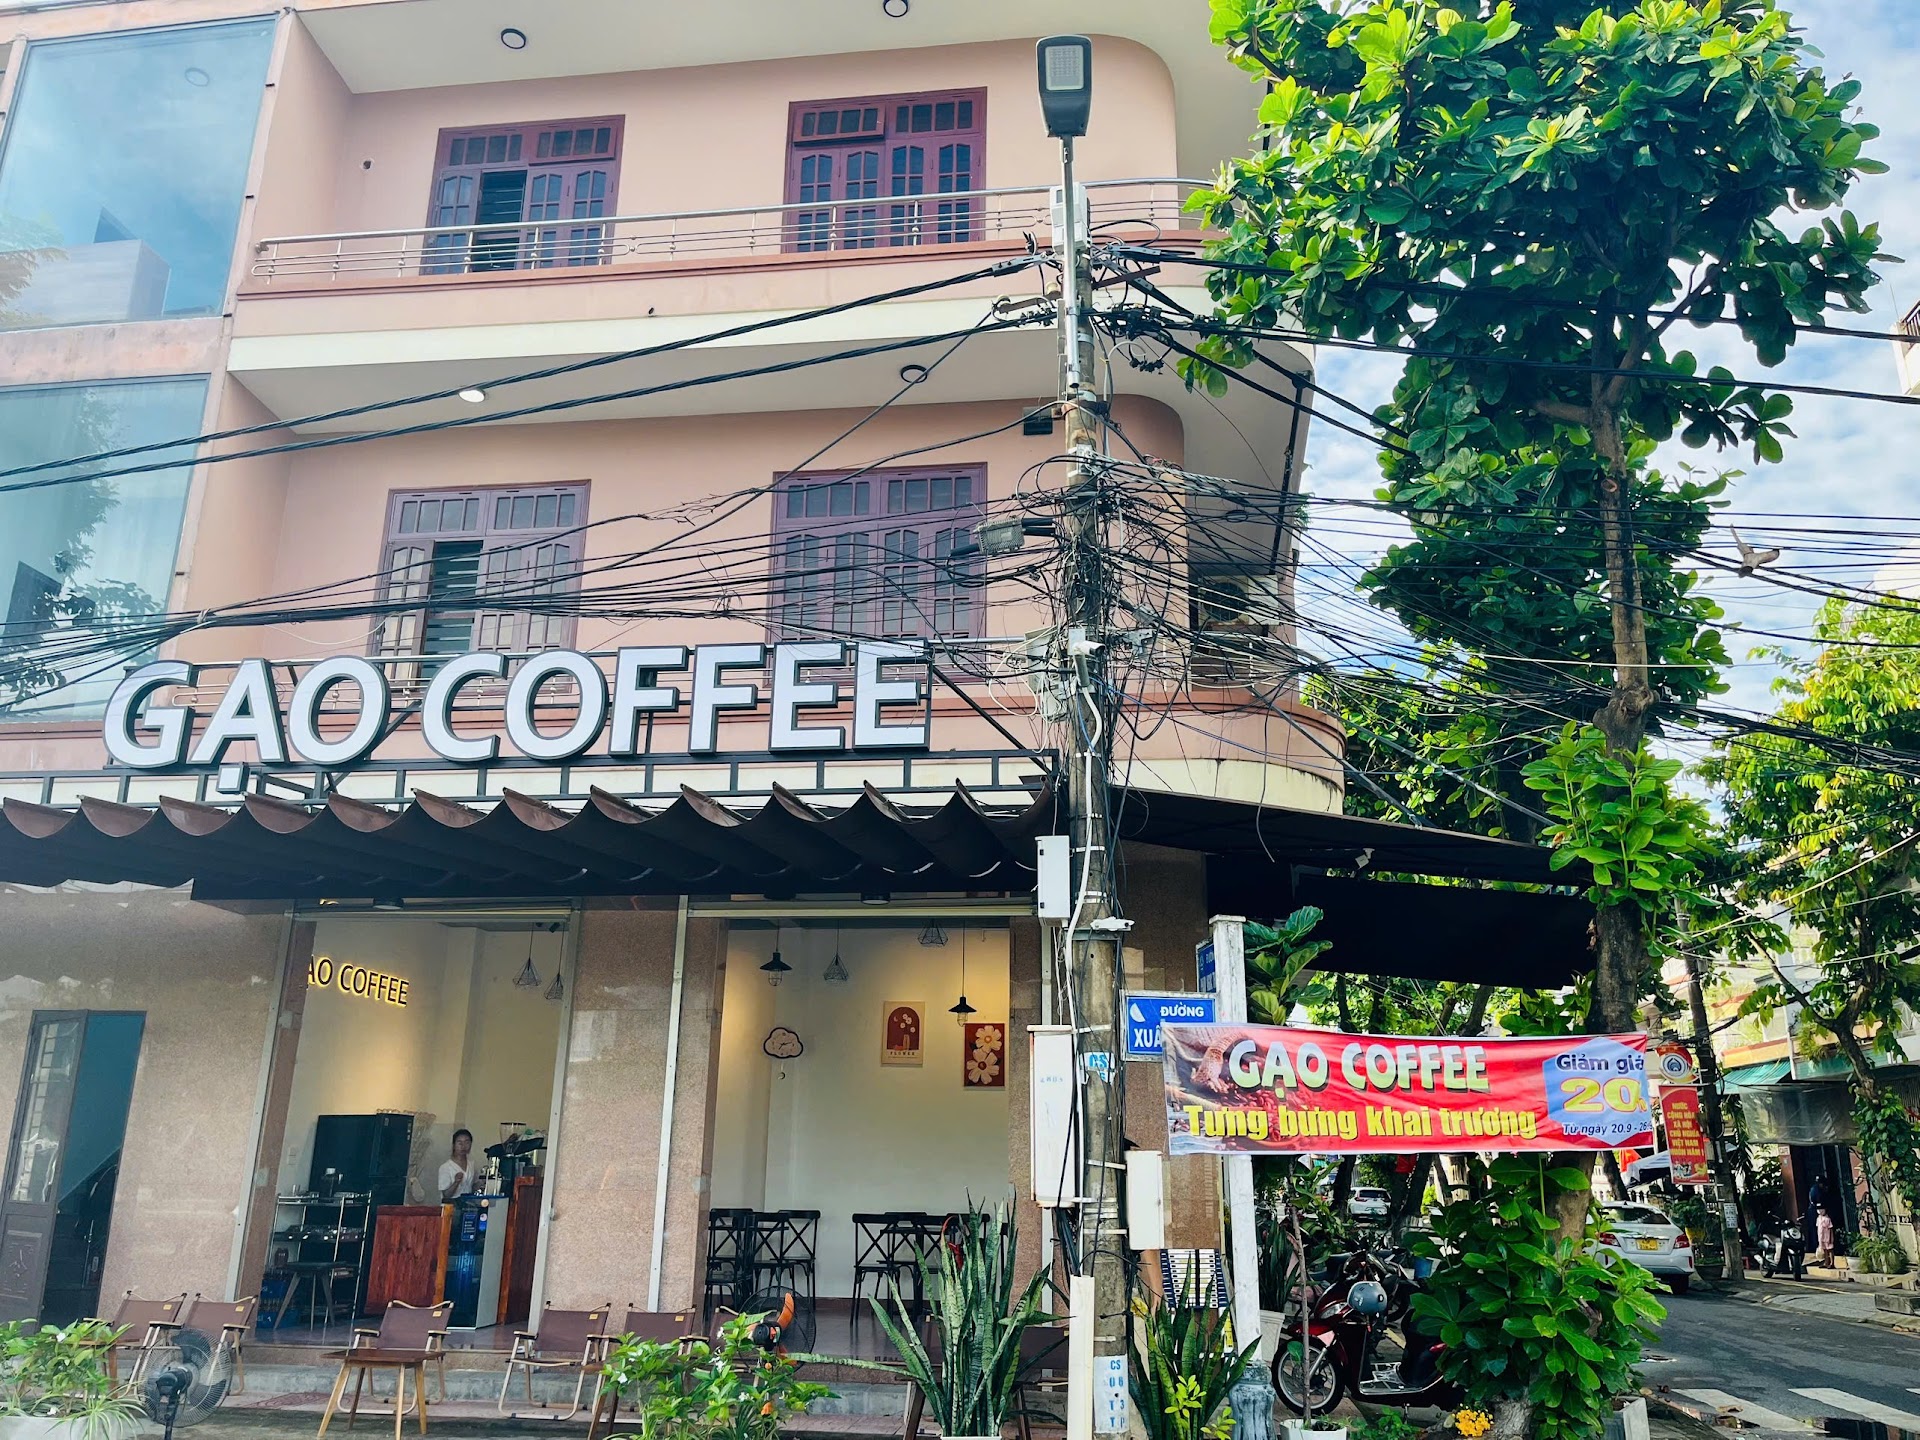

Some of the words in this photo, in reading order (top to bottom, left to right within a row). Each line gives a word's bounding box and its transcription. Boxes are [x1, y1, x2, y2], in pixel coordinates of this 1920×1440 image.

[102, 657, 390, 796] GẠO
[421, 641, 931, 764] COFFEE
[339, 963, 409, 1006] COFFEE
[1160, 1002, 1205, 1017] ĐƯỜNG
[1134, 1025, 1162, 1048] XUÂ
[1229, 1039, 1329, 1099] GẠO
[1342, 1043, 1490, 1093] COFFEE
[1557, 1053, 1609, 1071] Giảm
[1616, 1054, 1644, 1075] giá
[1279, 1105, 1358, 1140] bừng
[1365, 1105, 1433, 1137] khai
[1439, 1106, 1538, 1140] trương
[1563, 1122, 1579, 1134] Từ
[1581, 1125, 1608, 1136] ngày
[1611, 1123, 1632, 1134] 20.9
[1110, 1359, 1121, 1370] CS
